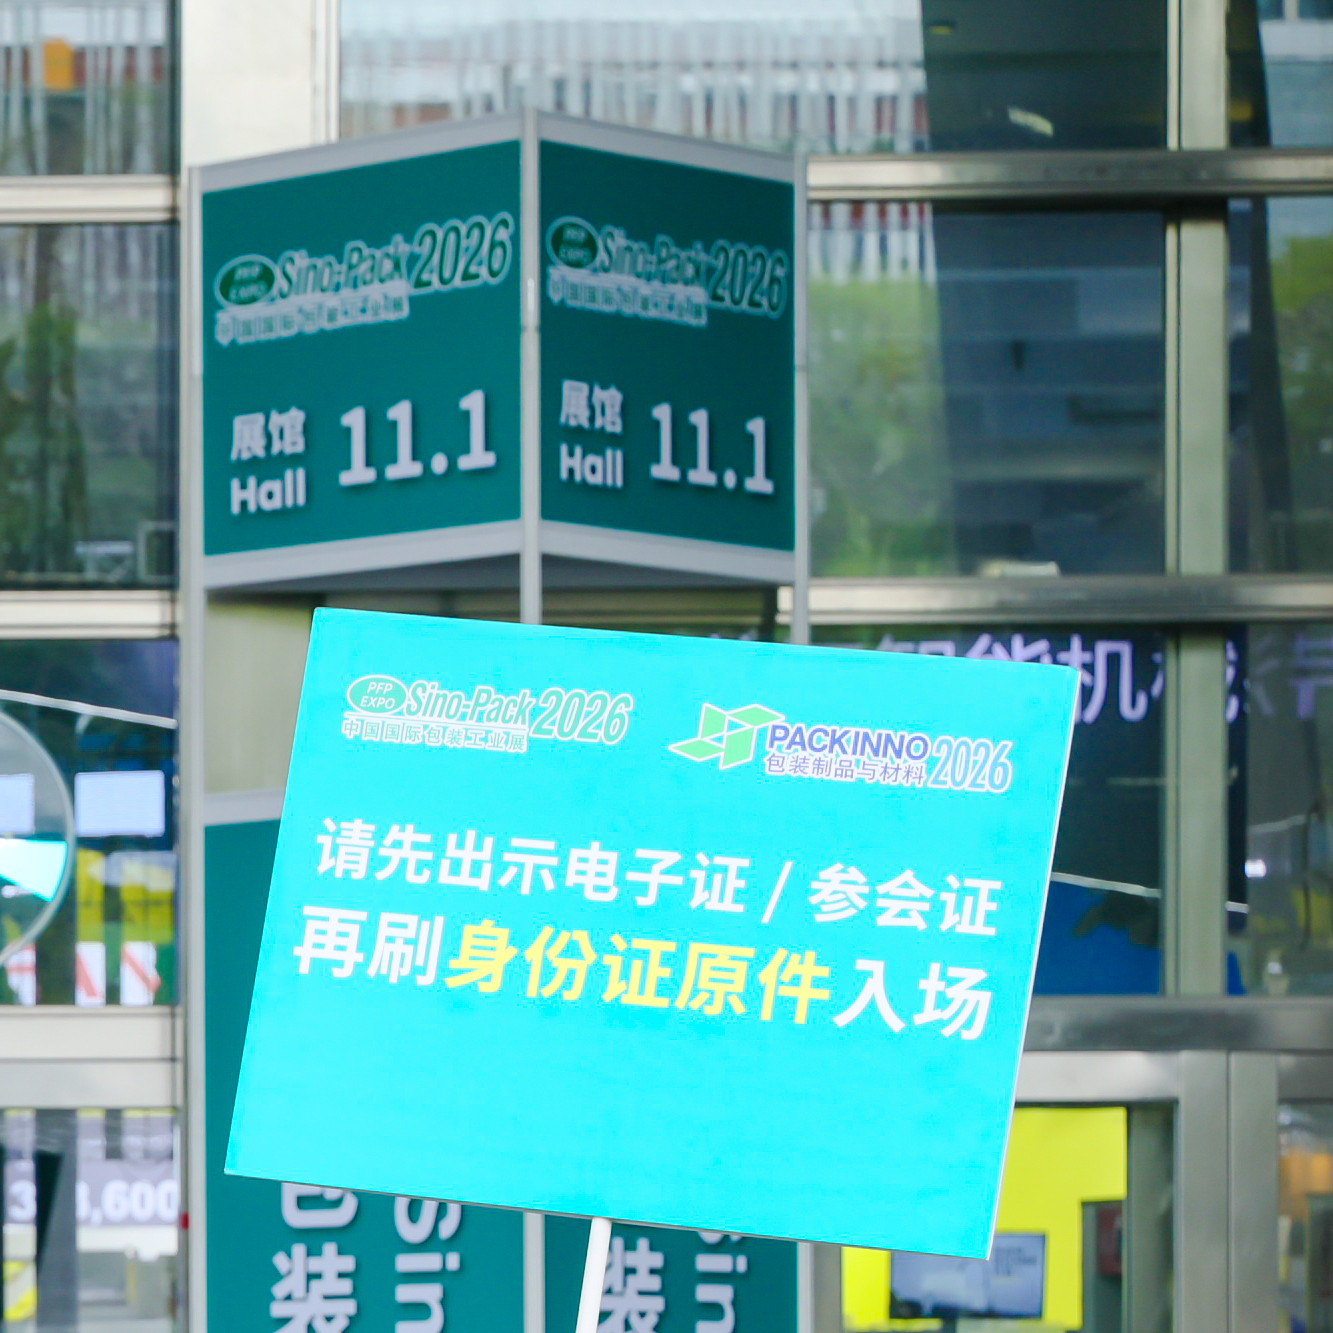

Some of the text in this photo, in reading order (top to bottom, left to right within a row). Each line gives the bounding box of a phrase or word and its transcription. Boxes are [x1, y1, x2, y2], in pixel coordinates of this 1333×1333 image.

[411, 212, 514, 292] 2026
[708, 242, 790, 318] 2026
[230, 406, 307, 461] 展馆
[559, 380, 624, 434] 展馆
[230, 389, 498, 515] Hall 11.1
[559, 403, 775, 495] Hall 11.1
[359, 696, 396, 710] EXPO
[366, 681, 393, 695] PFP
[405, 681, 632, 744] Sino-Pack 2026
[342, 718, 527, 752] 中国国际包装工业展
[767, 724, 1013, 792] PACKINNO 2026
[765, 752, 927, 786] 包装制品与材料
[316, 817, 748, 914] 请先出示电子证
[809, 860, 1003, 937] 参会证
[292, 903, 994, 1042] 再刷身份证原件入场
